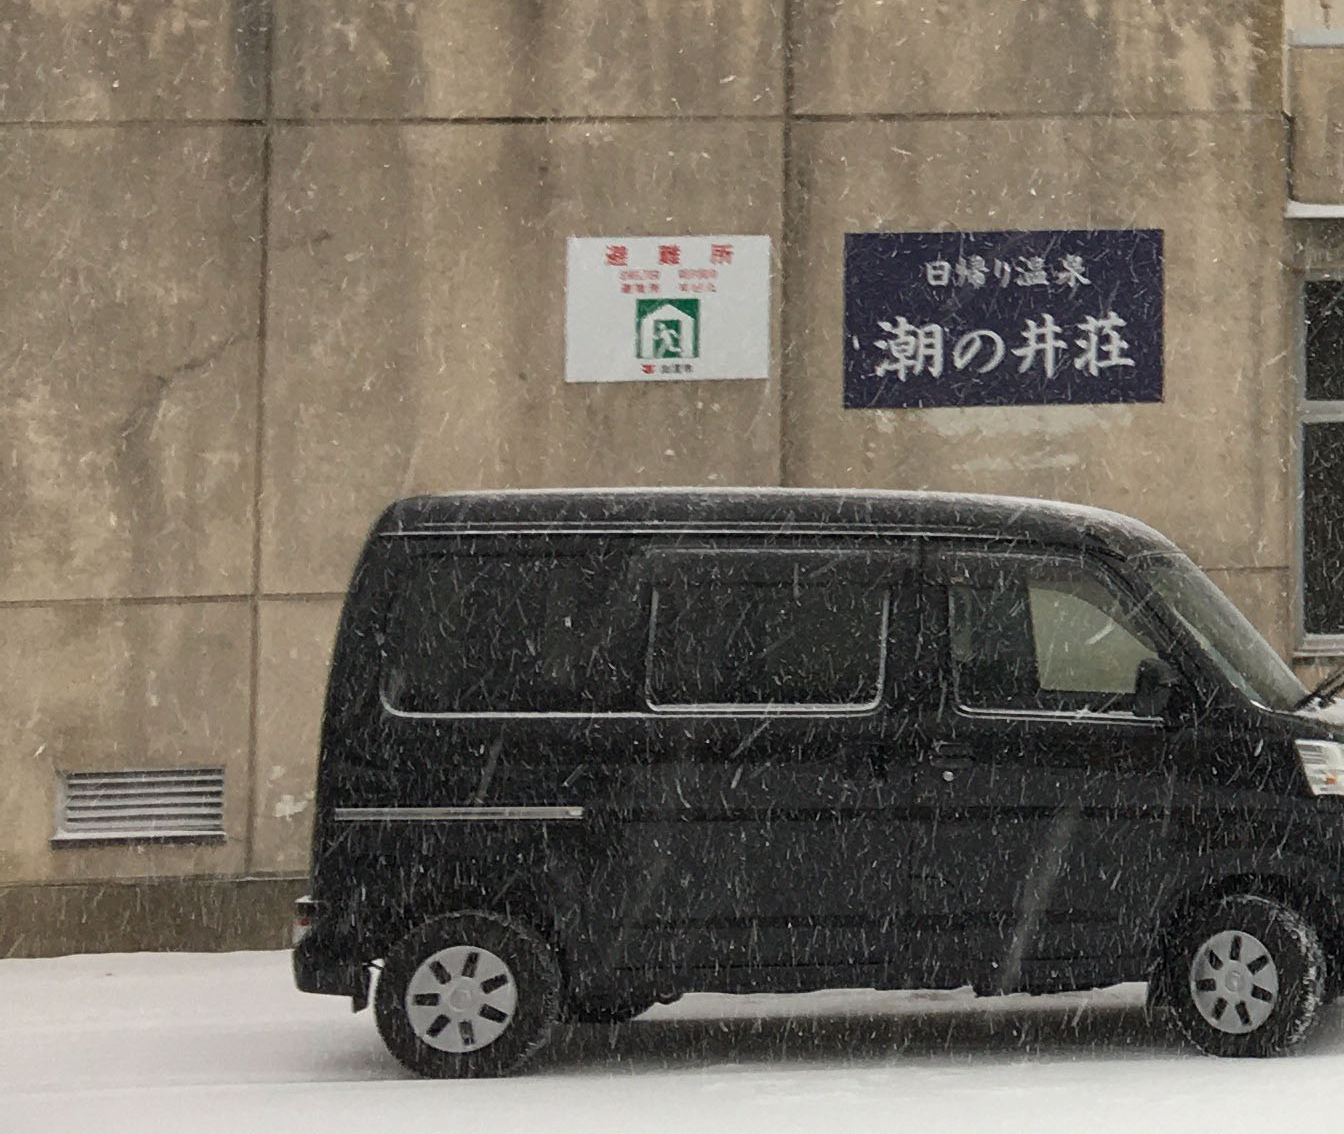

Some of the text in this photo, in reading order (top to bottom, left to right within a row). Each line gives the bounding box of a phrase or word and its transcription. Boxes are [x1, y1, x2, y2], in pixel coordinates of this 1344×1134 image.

[926, 253, 1091, 288] 日帰り温泉
[874, 312, 1135, 381] 潮の井荘
